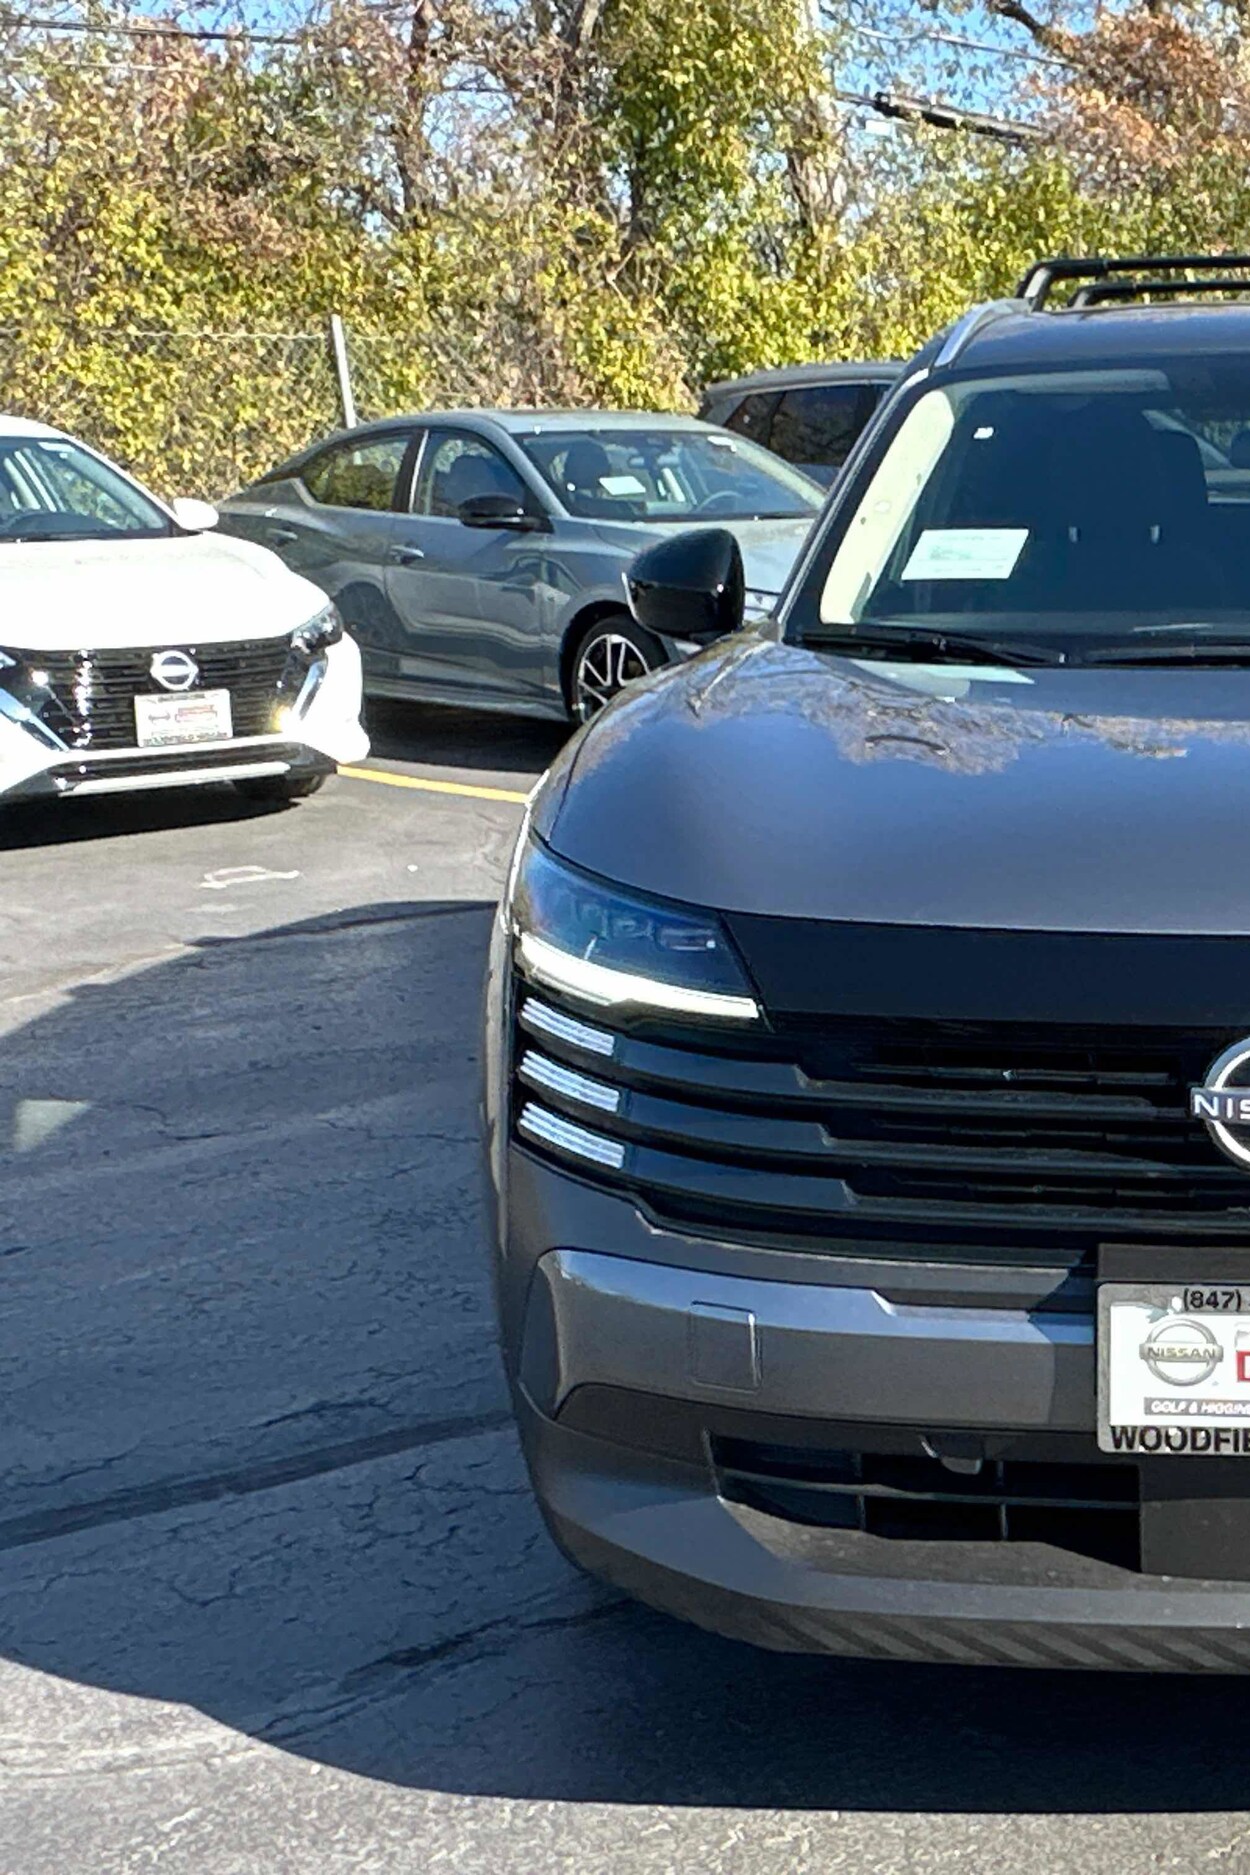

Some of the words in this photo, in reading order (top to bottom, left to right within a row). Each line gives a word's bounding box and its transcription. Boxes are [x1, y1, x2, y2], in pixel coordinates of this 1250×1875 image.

[1183, 1288, 1242, 1312] (847)
[1147, 1346, 1216, 1359] NISSAN
[1151, 1400, 1186, 1413] GOLF
